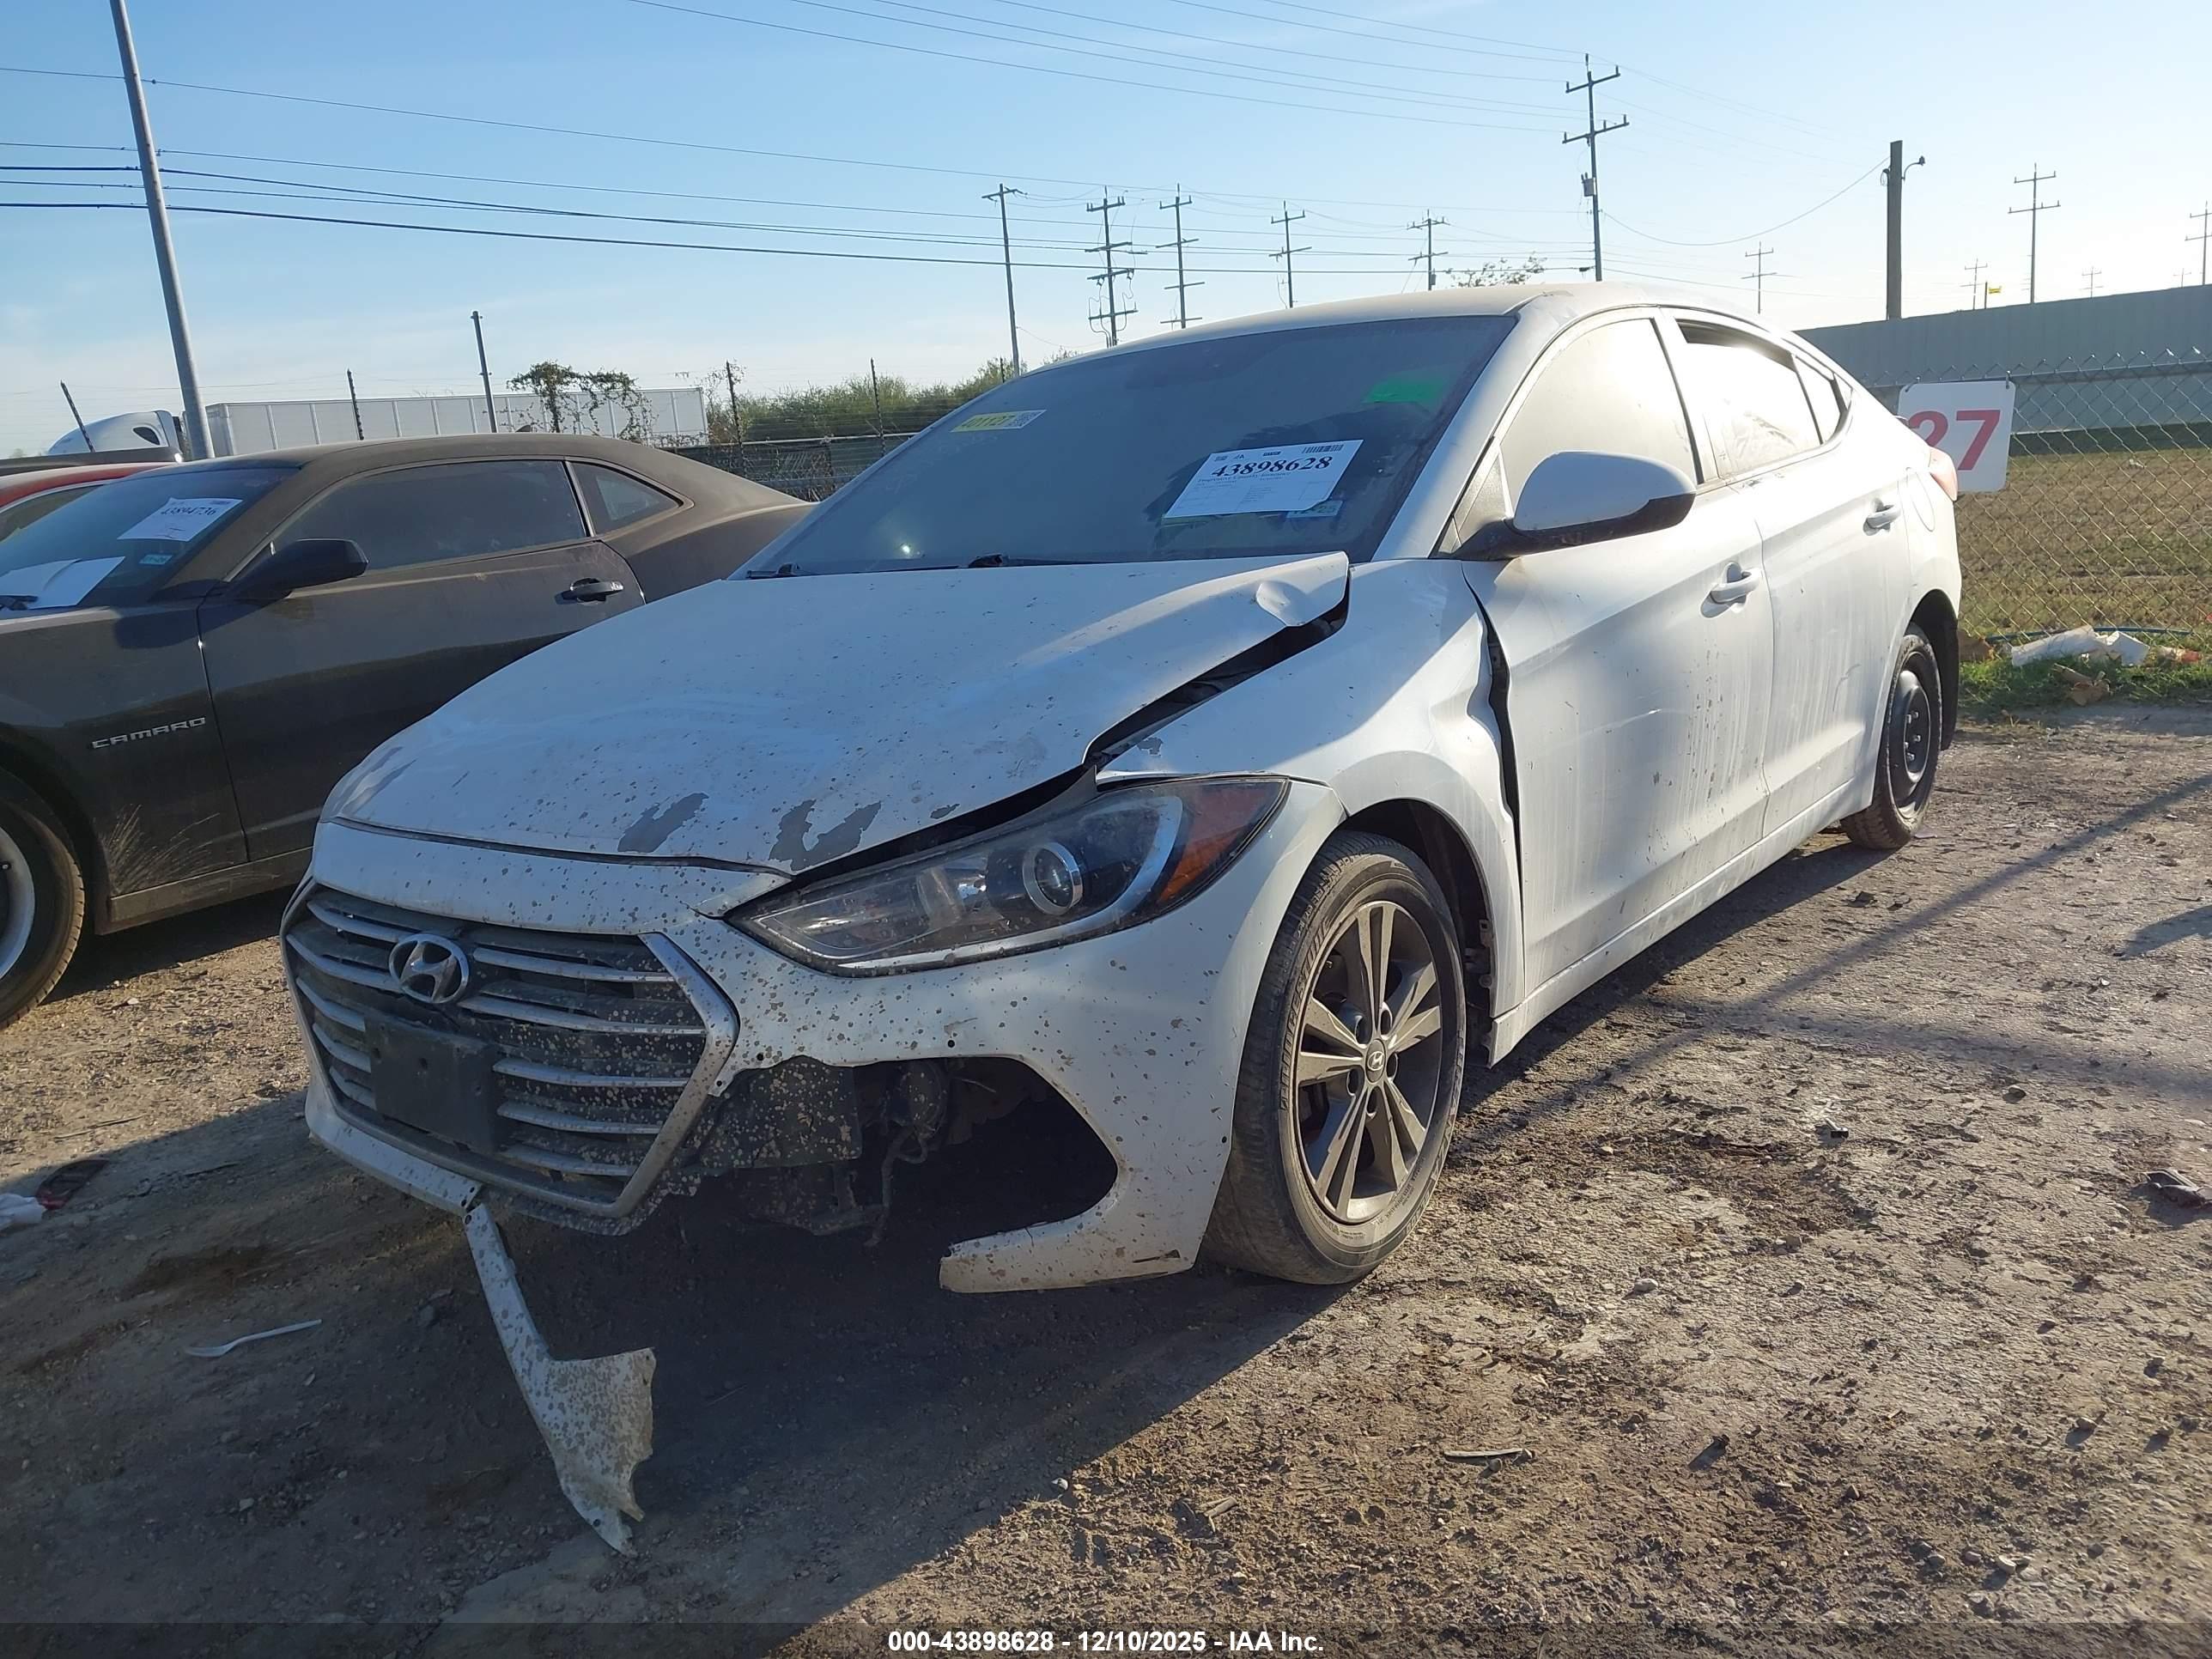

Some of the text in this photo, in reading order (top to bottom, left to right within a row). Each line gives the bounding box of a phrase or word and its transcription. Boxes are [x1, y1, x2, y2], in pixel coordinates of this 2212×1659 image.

[1908, 410, 2001, 471] 27
[1211, 455, 1333, 478] 43898628
[91, 717, 206, 749] CAMARO
[1280, 916, 1332, 1110] BRIDGESTONE
